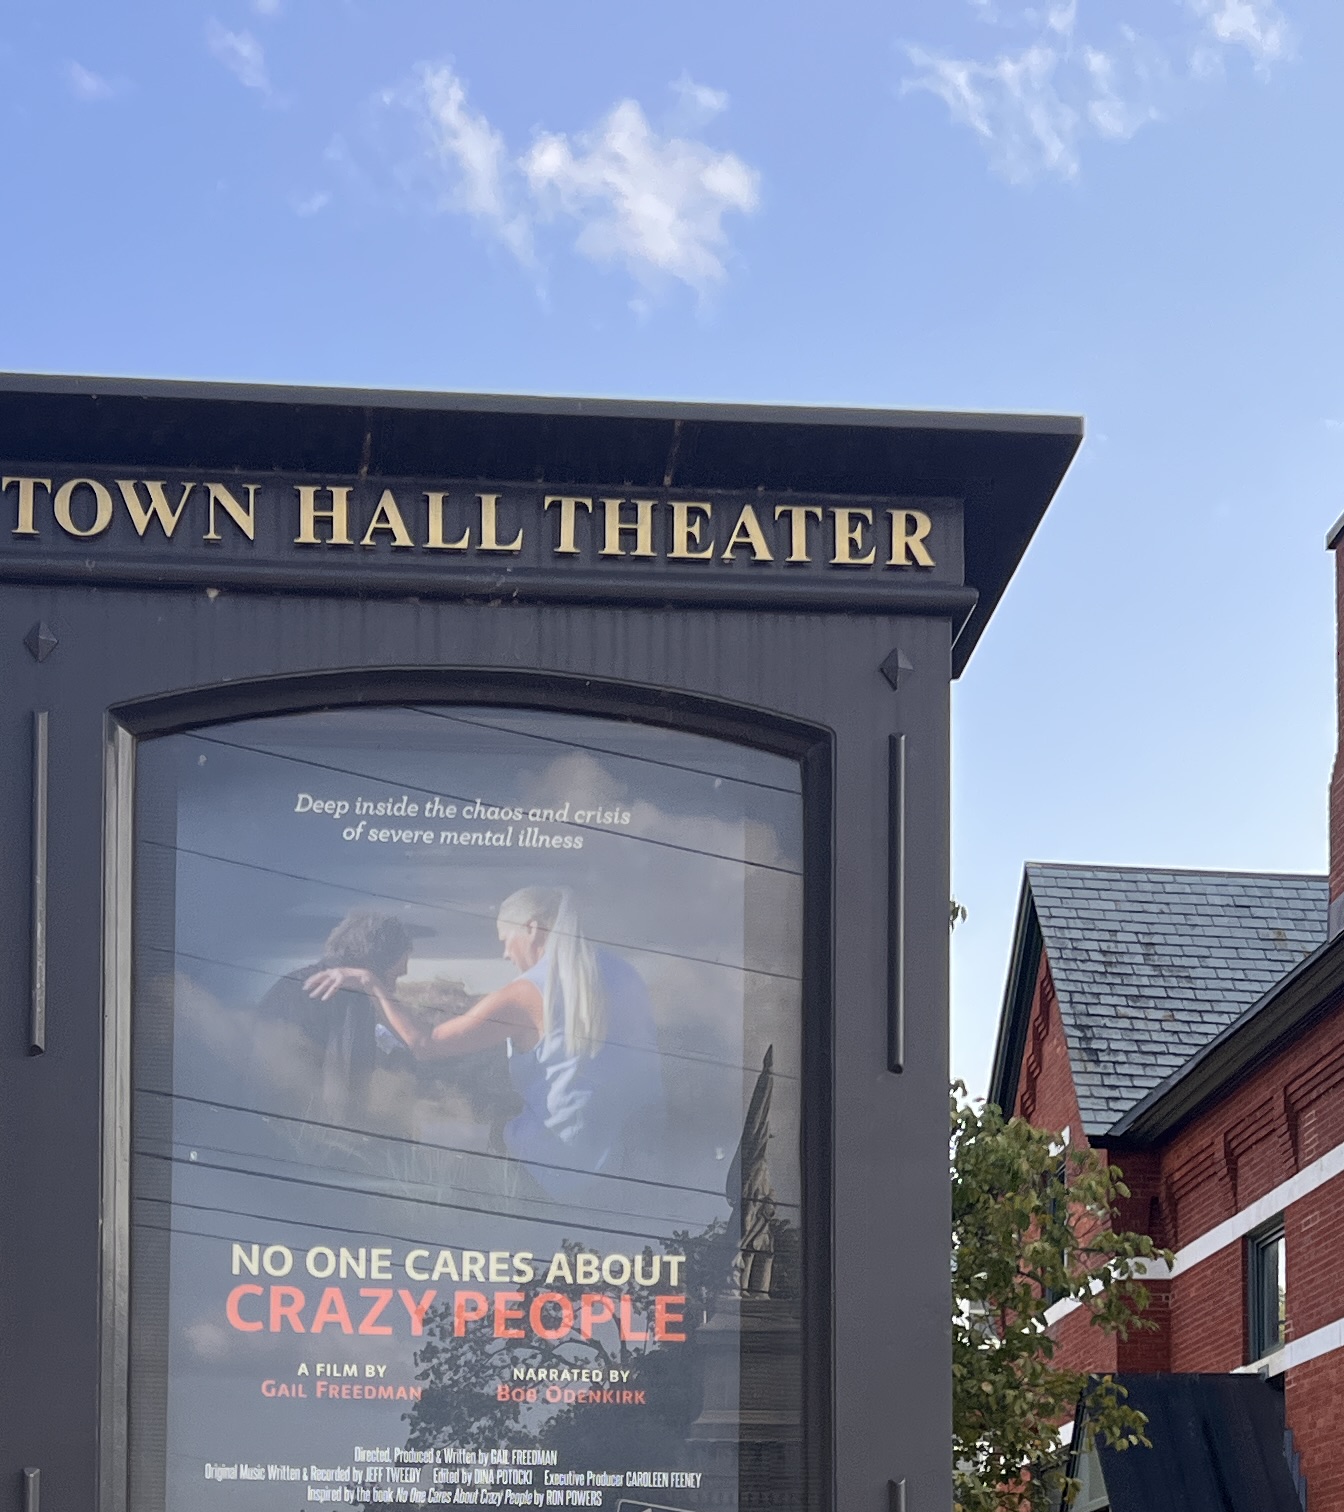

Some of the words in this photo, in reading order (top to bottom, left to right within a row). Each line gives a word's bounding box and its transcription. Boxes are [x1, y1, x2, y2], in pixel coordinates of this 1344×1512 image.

[1, 476, 261, 541] TOWN
[294, 485, 524, 551] HALL
[544, 495, 936, 567] THEATER
[294, 793, 349, 819] Deep
[355, 795, 419, 819] inside
[425, 798, 457, 820] the
[462, 799, 522, 822] chaos
[529, 803, 568, 822] and
[575, 805, 631, 825] crisis
[343, 822, 364, 841] of
[368, 827, 434, 845] severe
[440, 826, 512, 847] mental
[518, 828, 583, 849] illness
[232, 1243, 293, 1276] NO
[306, 1246, 392, 1279] ONE
[405, 1249, 534, 1284] CARES
[545, 1253, 686, 1286] ABOUT
[226, 1284, 437, 1336] CRAZY
[453, 1290, 686, 1342] PEOPLE
[298, 1363, 309, 1376] A
[316, 1363, 358, 1377] FILM
[365, 1364, 386, 1378] BY
[513, 1367, 602, 1382] NARRATED
[610, 1370, 630, 1382] BY
[355, 1446, 392, 1463] Directed,
[394, 1448, 434, 1464] Produced
[436, 1450, 442, 1464] &
[444, 1449, 476, 1464] Written
[478, 1450, 489, 1466] by
[491, 1449, 509, 1465] GAIL
[511, 1450, 557, 1465] FREEDMAN
[205, 1463, 238, 1481] Original
[239, 1464, 265, 1480] Music
[268, 1465, 300, 1481] Written
[302, 1468, 308, 1481] &
[310, 1466, 350, 1482] Recorded
[352, 1466, 363, 1483] by
[365, 1467, 383, 1482] JEFF
[385, 1468, 421, 1483] TWEEDY
[433, 1468, 459, 1483] Edited
[462, 1469, 473, 1486] by
[475, 1469, 494, 1484] DINA
[496, 1470, 533, 1485] POTOCKI
[544, 1470, 585, 1486] Executive
[586, 1471, 624, 1487] Producer
[625, 1471, 669, 1488] CAROLEEN
[670, 1472, 702, 1489] FEENEY
[307, 1486, 342, 1502] Inspired
[344, 1486, 354, 1504] by
[357, 1487, 371, 1502] the
[373, 1487, 393, 1503] book
[396, 1487, 408, 1503] No
[410, 1488, 426, 1503] One
[427, 1488, 452, 1503] Cares
[453, 1488, 478, 1504] About
[480, 1489, 504, 1506] Crazy
[504, 1489, 532, 1507] People
[533, 1490, 544, 1507] by
[546, 1490, 564, 1506] RON
[565, 1491, 603, 1506] POWERS
